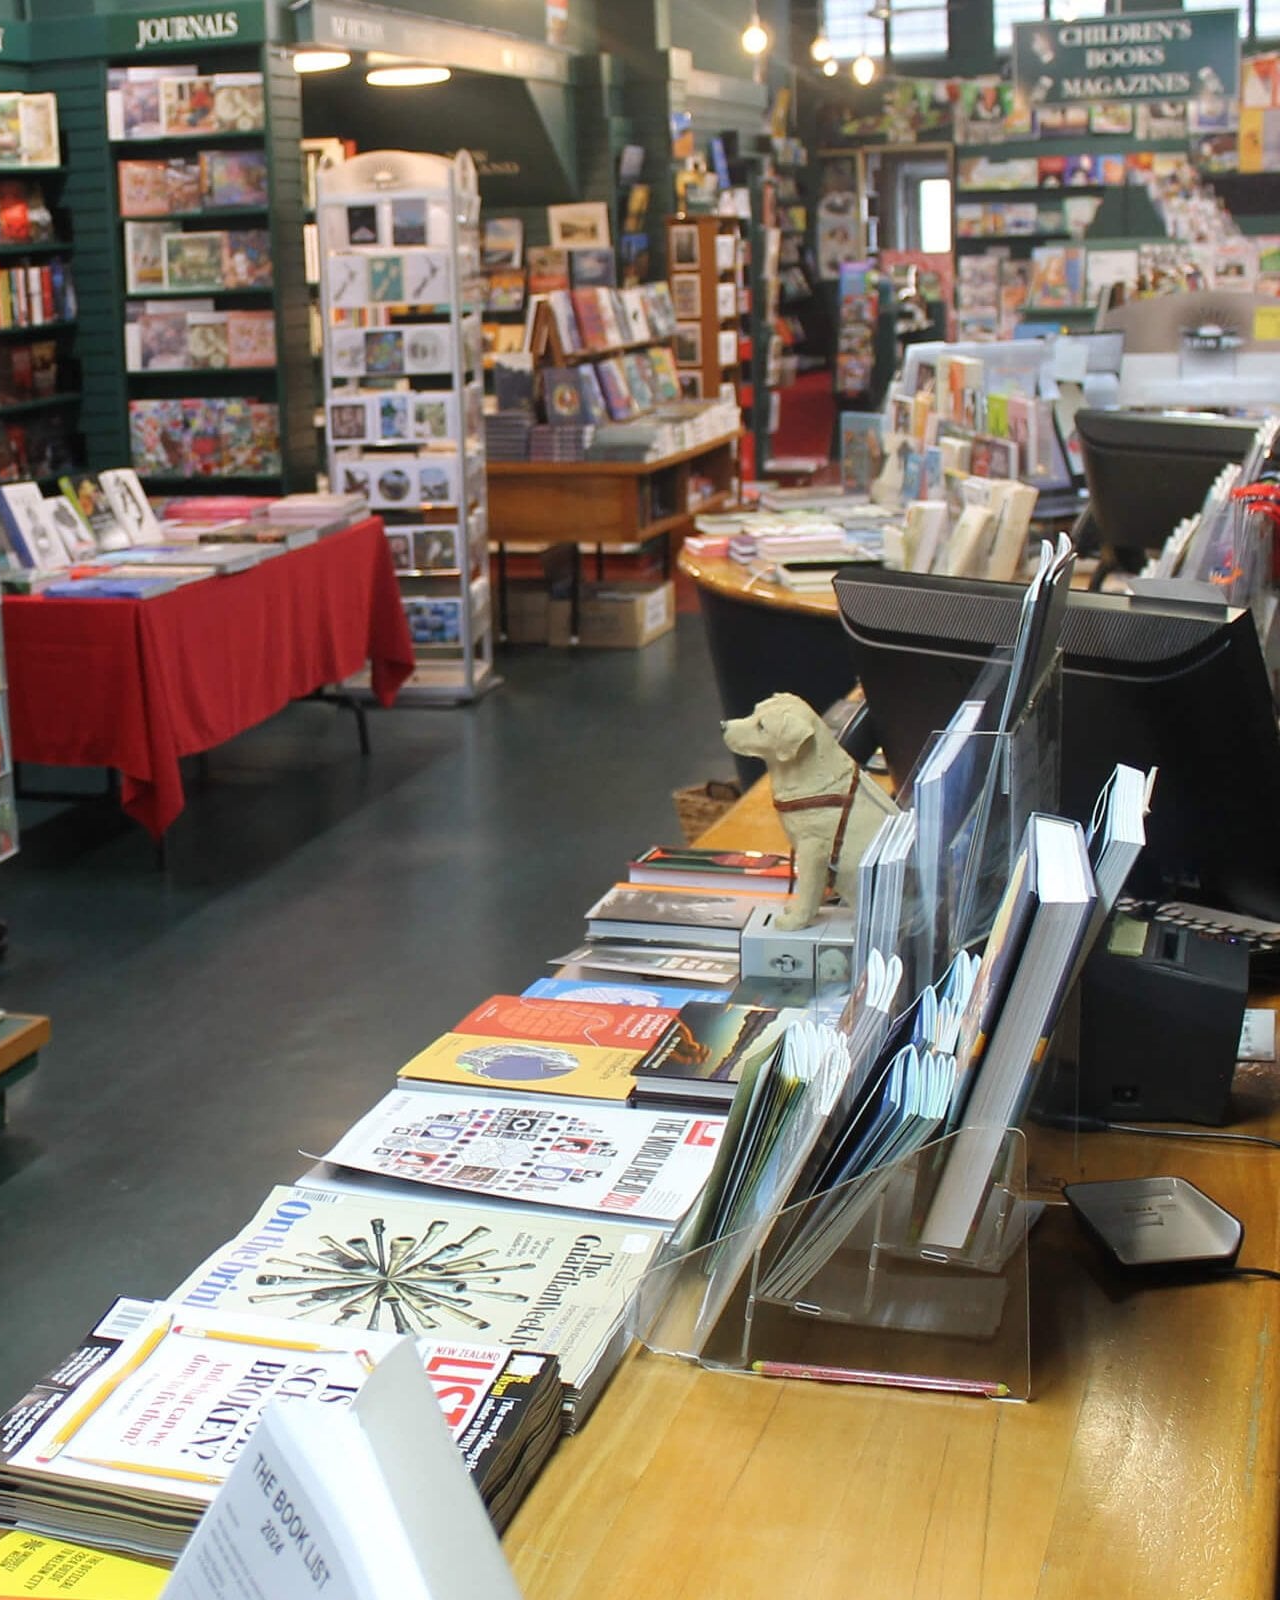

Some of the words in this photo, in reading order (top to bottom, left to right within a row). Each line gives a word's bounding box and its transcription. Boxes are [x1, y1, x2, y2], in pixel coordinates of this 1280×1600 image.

[136, 12, 239, 48] JOURNALS
[1058, 19, 1193, 47] CHILDREN'S
[1085, 45, 1165, 69] BOOKS
[1062, 72, 1191, 97] MAGAZINES
[651, 1117, 691, 1138] THE
[631, 1135, 680, 1169] WORLD
[612, 1165, 660, 1196] AHEAD
[263, 1200, 313, 1234] On
[231, 1235, 285, 1260] the
[582, 1249, 615, 1279] The
[434, 1346, 458, 1357] NEW
[458, 1347, 501, 1362] ZEALAND
[201, 1361, 234, 1381] And
[148, 1390, 181, 1407] fix
[177, 1381, 214, 1406] what
[157, 1406, 190, 1429] can
[180, 1359, 287, 1462] BROKEN?
[113, 1408, 166, 1446] them?
[143, 1430, 171, 1447] we
[252, 1452, 279, 1498] THE
[272, 1489, 310, 1547] BOOK
[303, 1542, 331, 1590] LIST
[259, 1519, 285, 1556] 2024
[24, 1570, 45, 1591] CITY
